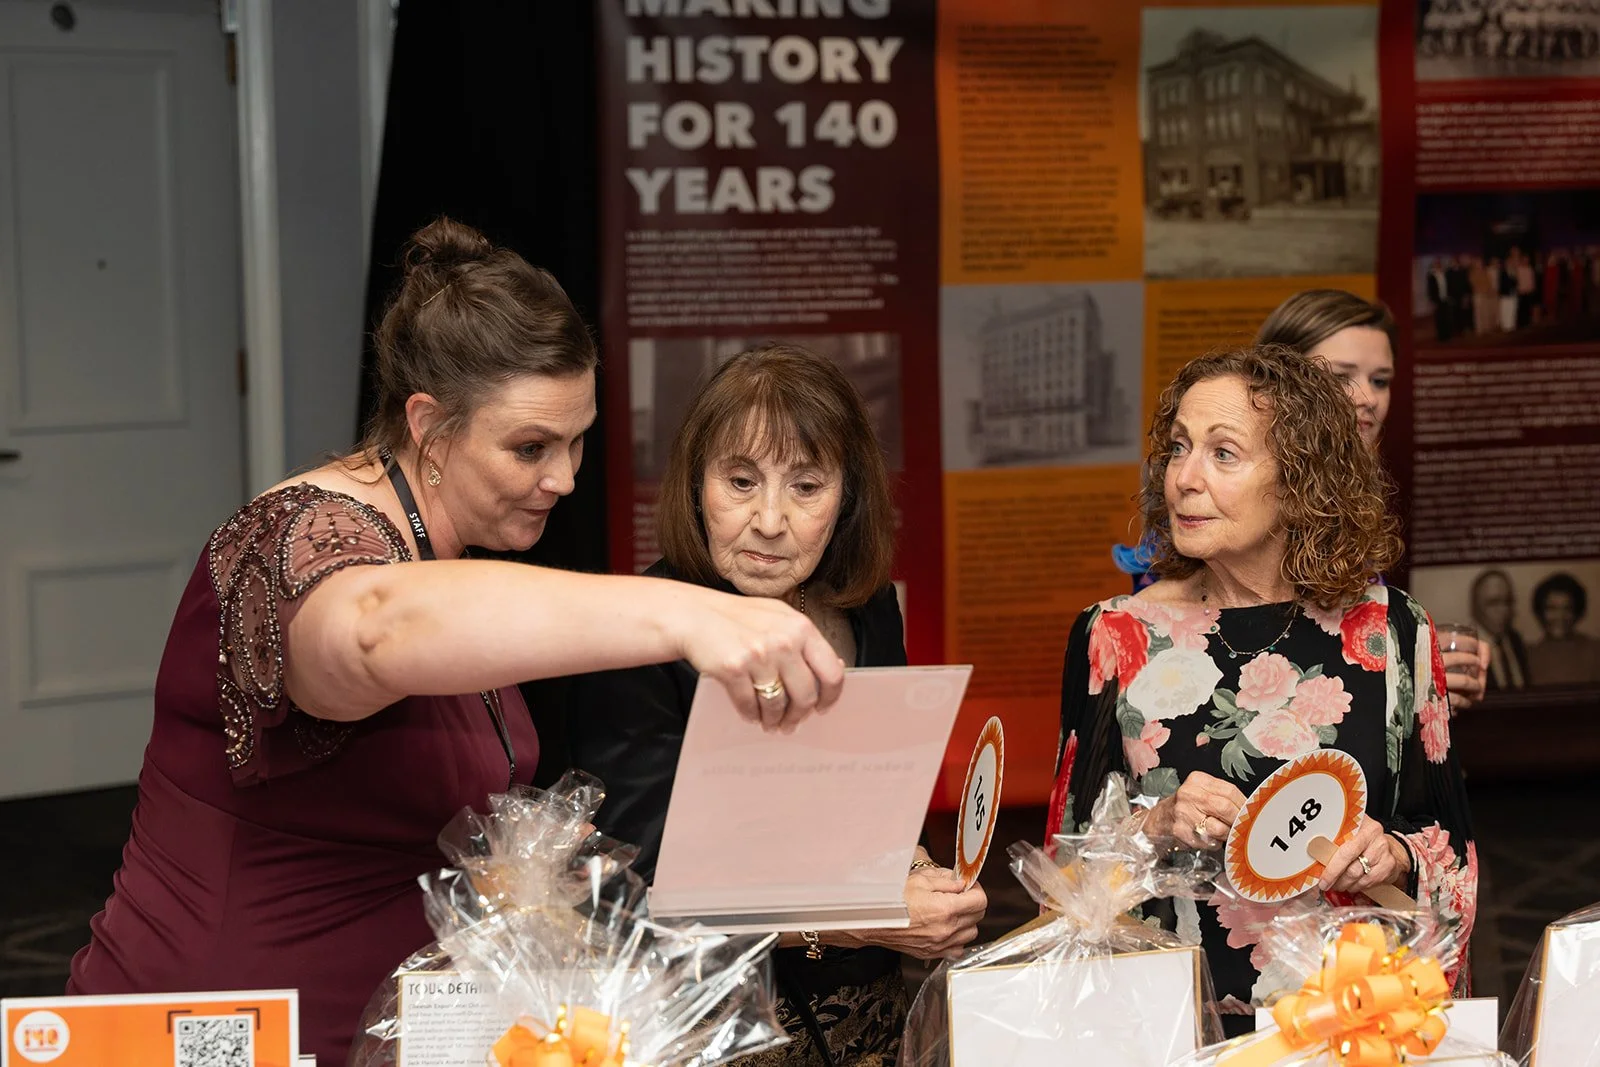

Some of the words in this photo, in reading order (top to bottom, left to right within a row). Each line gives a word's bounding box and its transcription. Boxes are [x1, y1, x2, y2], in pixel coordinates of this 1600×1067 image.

[626, 36, 903, 84] HISTORY
[627, 100, 757, 149] FOR
[774, 100, 898, 149] 140
[625, 164, 835, 215] YEARS
[409, 512, 426, 538] STAFF
[973, 775, 987, 832] 145
[1269, 798, 1323, 853] 148
